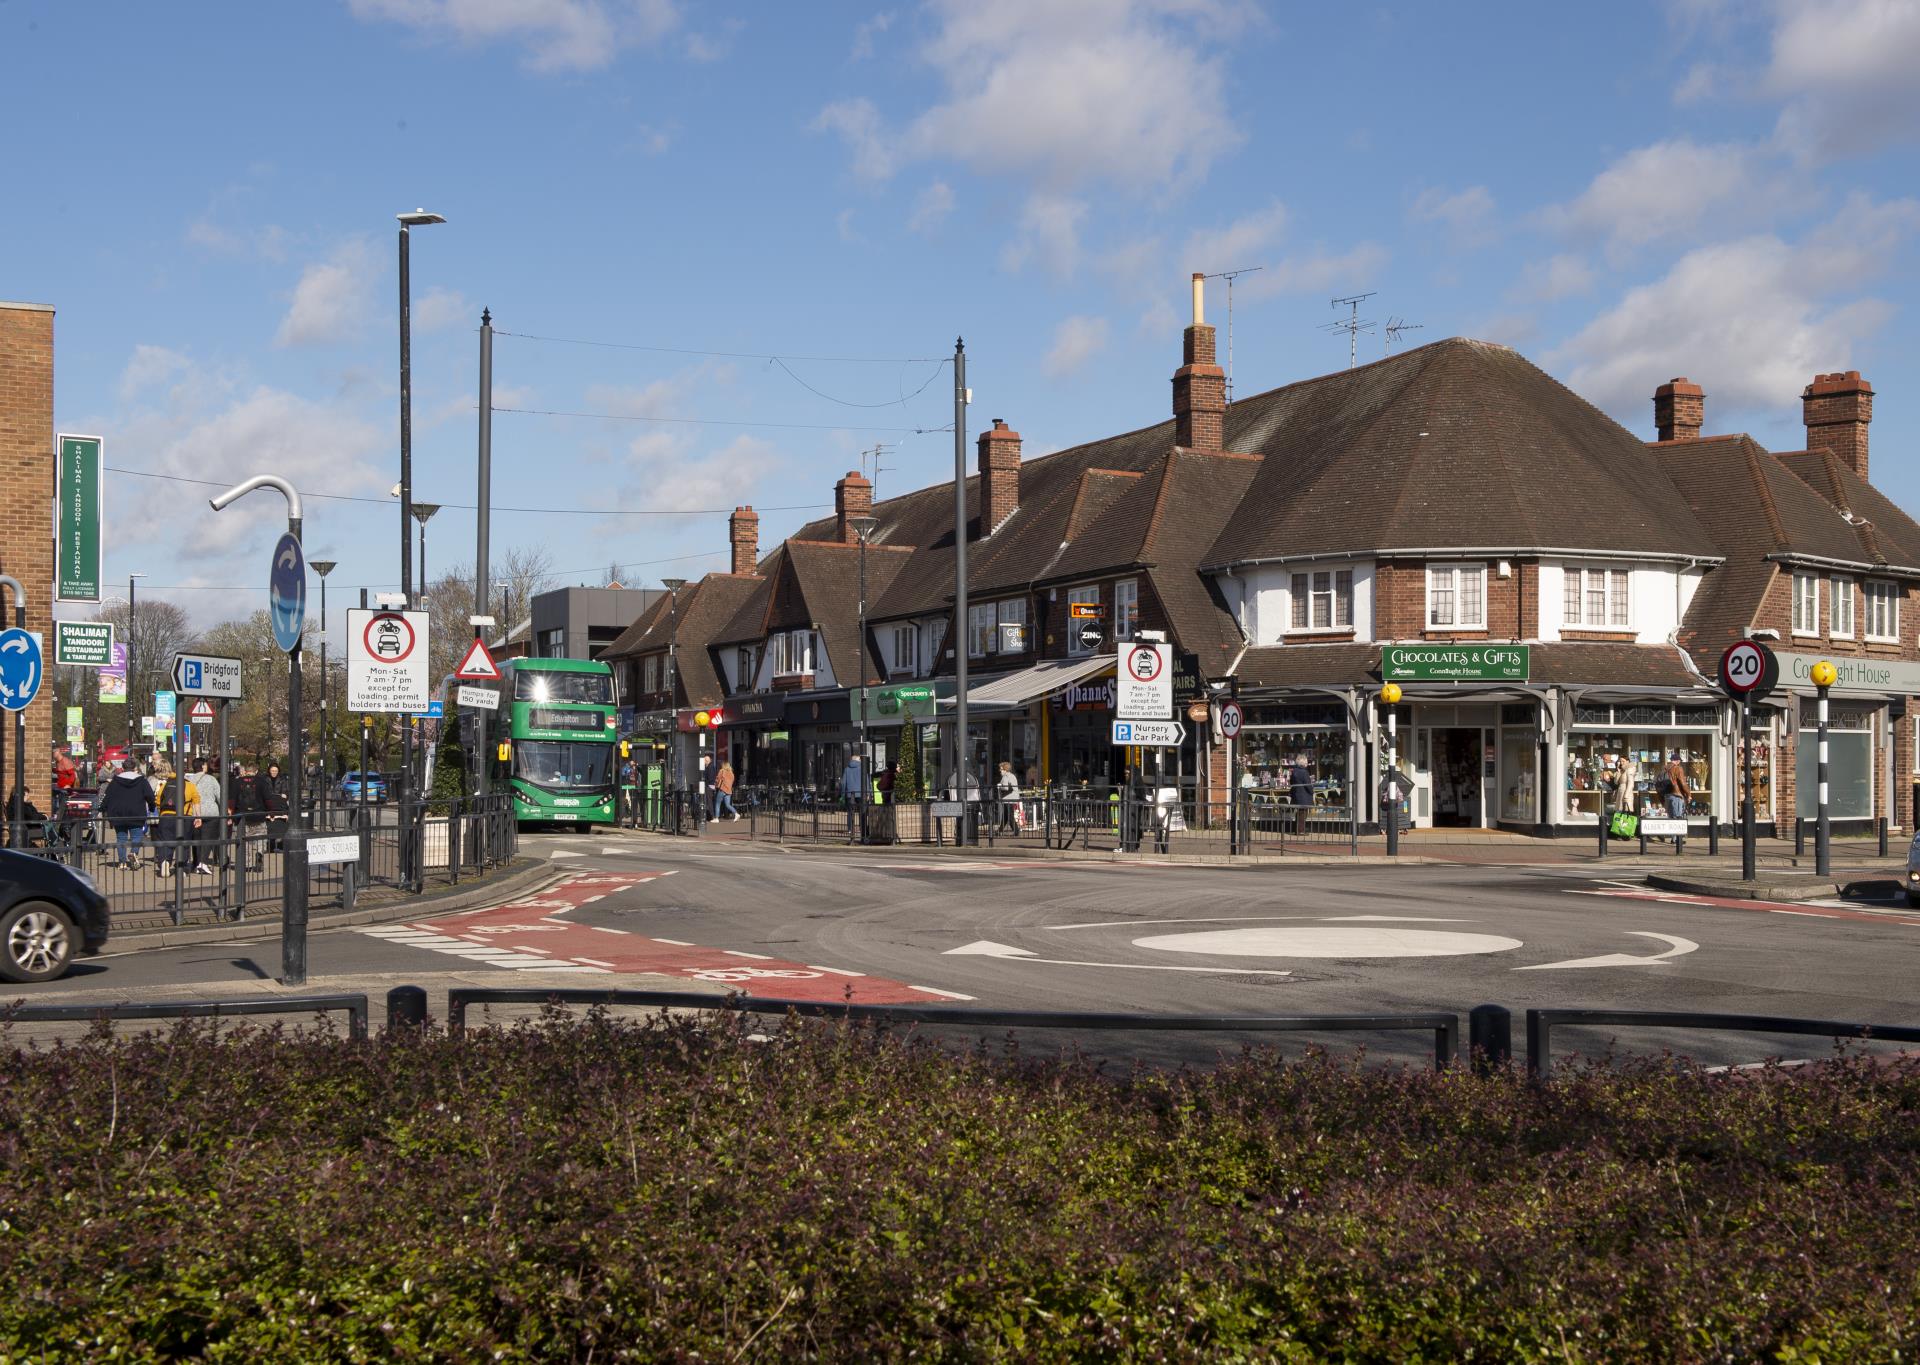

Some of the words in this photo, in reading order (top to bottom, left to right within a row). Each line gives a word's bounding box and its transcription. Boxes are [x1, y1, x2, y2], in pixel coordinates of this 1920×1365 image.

[62, 626, 108, 638] SHALIMAR
[66, 638, 104, 646] TANDOORI
[1472, 652, 1480, 662] &
[204, 662, 238, 676] Bridgford
[1173, 660, 1184, 672] AL
[1730, 655, 1759, 676] 20
[1858, 666, 1891, 684] House
[212, 678, 230, 690] Road
[1172, 676, 1196, 688] PAIRS
[551, 714, 579, 723] Edwalton
[590, 714, 597, 726] 6
[1224, 712, 1238, 728] 20
[1136, 724, 1168, 733] Nursery
[308, 844, 326, 856] UDOR
[332, 841, 358, 854] SQUARE
